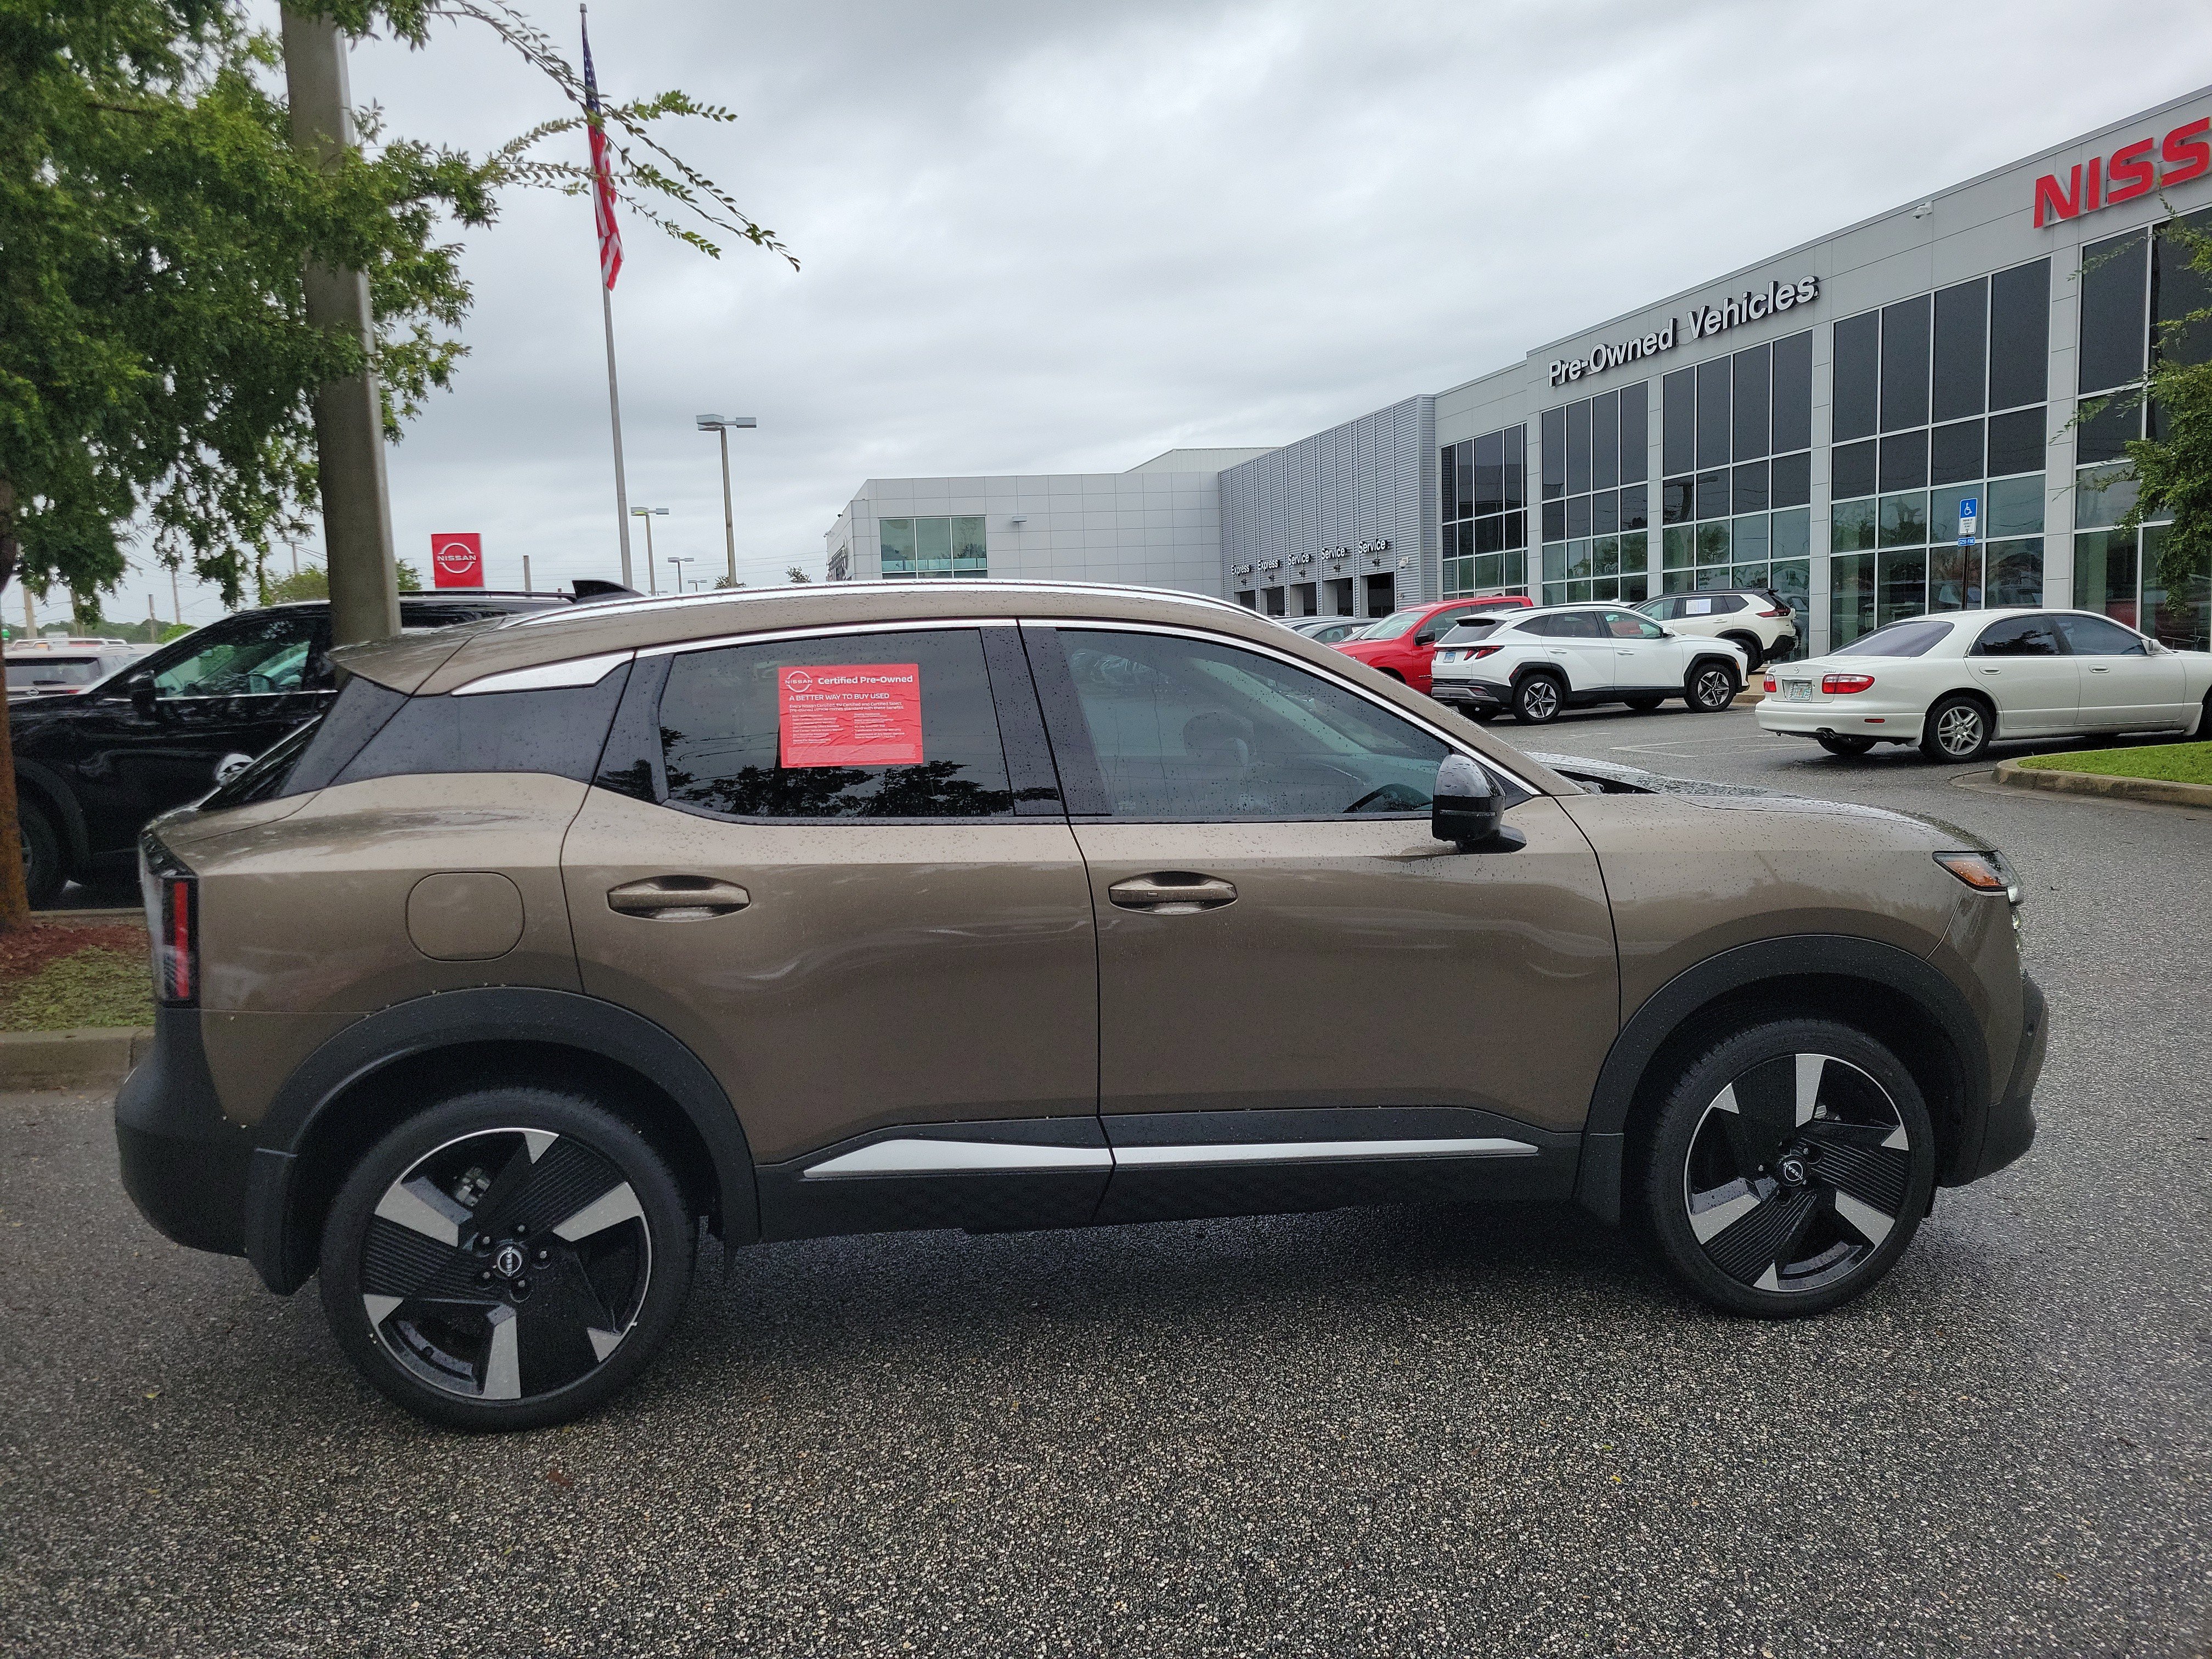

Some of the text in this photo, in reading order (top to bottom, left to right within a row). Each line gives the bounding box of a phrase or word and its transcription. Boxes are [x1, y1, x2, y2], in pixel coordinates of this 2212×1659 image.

[2034, 116, 2210, 228] NISS
[1548, 275, 1820, 387] Pre-Owned Vehicles
[1321, 546, 1346, 560] Service
[1358, 539, 1386, 554] Service
[1257, 559, 1279, 572] Express
[1288, 552, 1310, 566] Service
[1231, 565, 1250, 576] Express
[818, 675, 913, 685] Certified Pre-Owned
